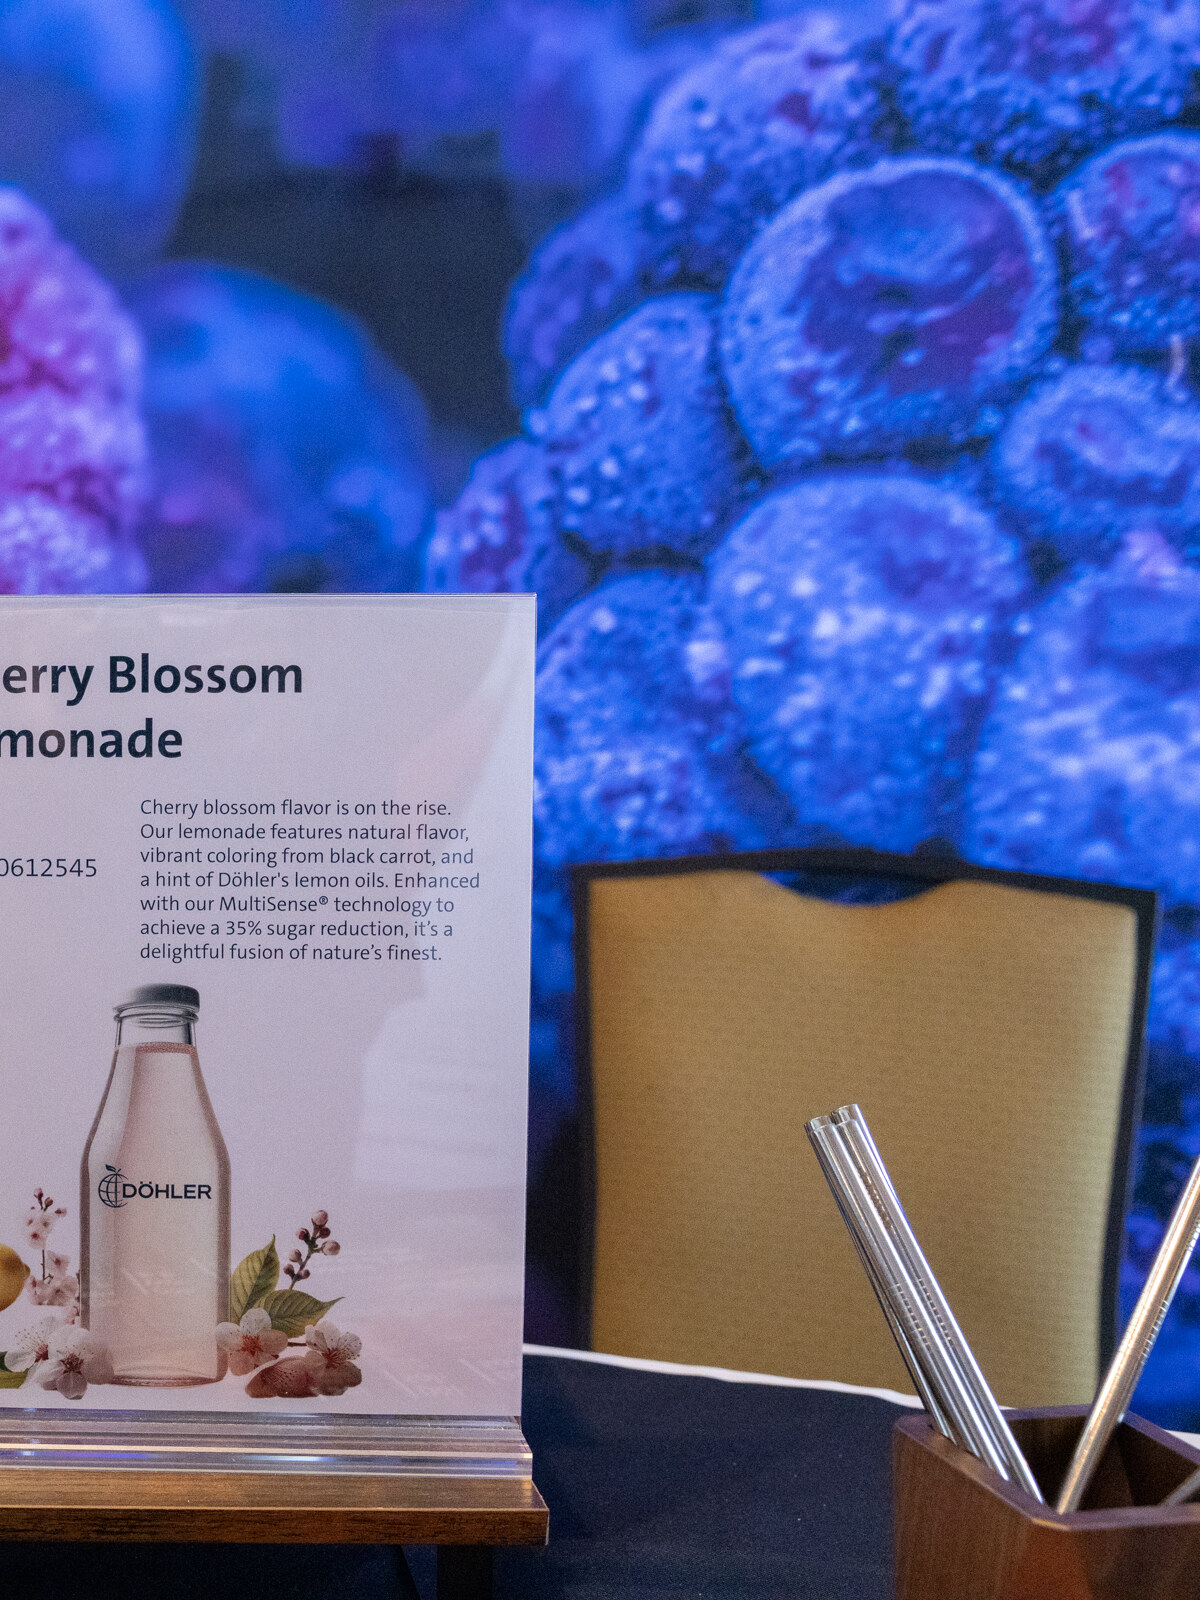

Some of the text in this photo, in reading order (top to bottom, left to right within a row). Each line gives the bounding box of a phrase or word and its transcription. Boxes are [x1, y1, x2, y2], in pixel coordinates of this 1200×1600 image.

[109, 652, 303, 694] Blossom
[140, 798, 452, 820] Cherry blossom flavor is on the rise.
[140, 822, 469, 842] Our lemonade features natural flavor,
[139, 846, 474, 869] vibrant coloring from black carrot, and
[140, 874, 150, 888] a
[155, 870, 191, 888] hint
[194, 870, 215, 888] of
[294, 871, 350, 888] lemon
[354, 871, 389, 889] oils.
[394, 871, 480, 889] Enhanced
[139, 894, 180, 912] with
[184, 899, 215, 912] our
[333, 895, 432, 918] technology
[435, 897, 455, 913] to
[139, 918, 206, 936] achieve
[210, 923, 220, 936] a
[225, 920, 263, 936] 35%
[266, 923, 316, 941] sugar
[320, 919, 409, 939] reduction,
[443, 924, 453, 937] a
[139, 942, 225, 965] delightful
[229, 942, 284, 960] fusion
[288, 943, 309, 960] of
[386, 943, 442, 961] finest.
[122, 1180, 212, 1200] DÖHLER
